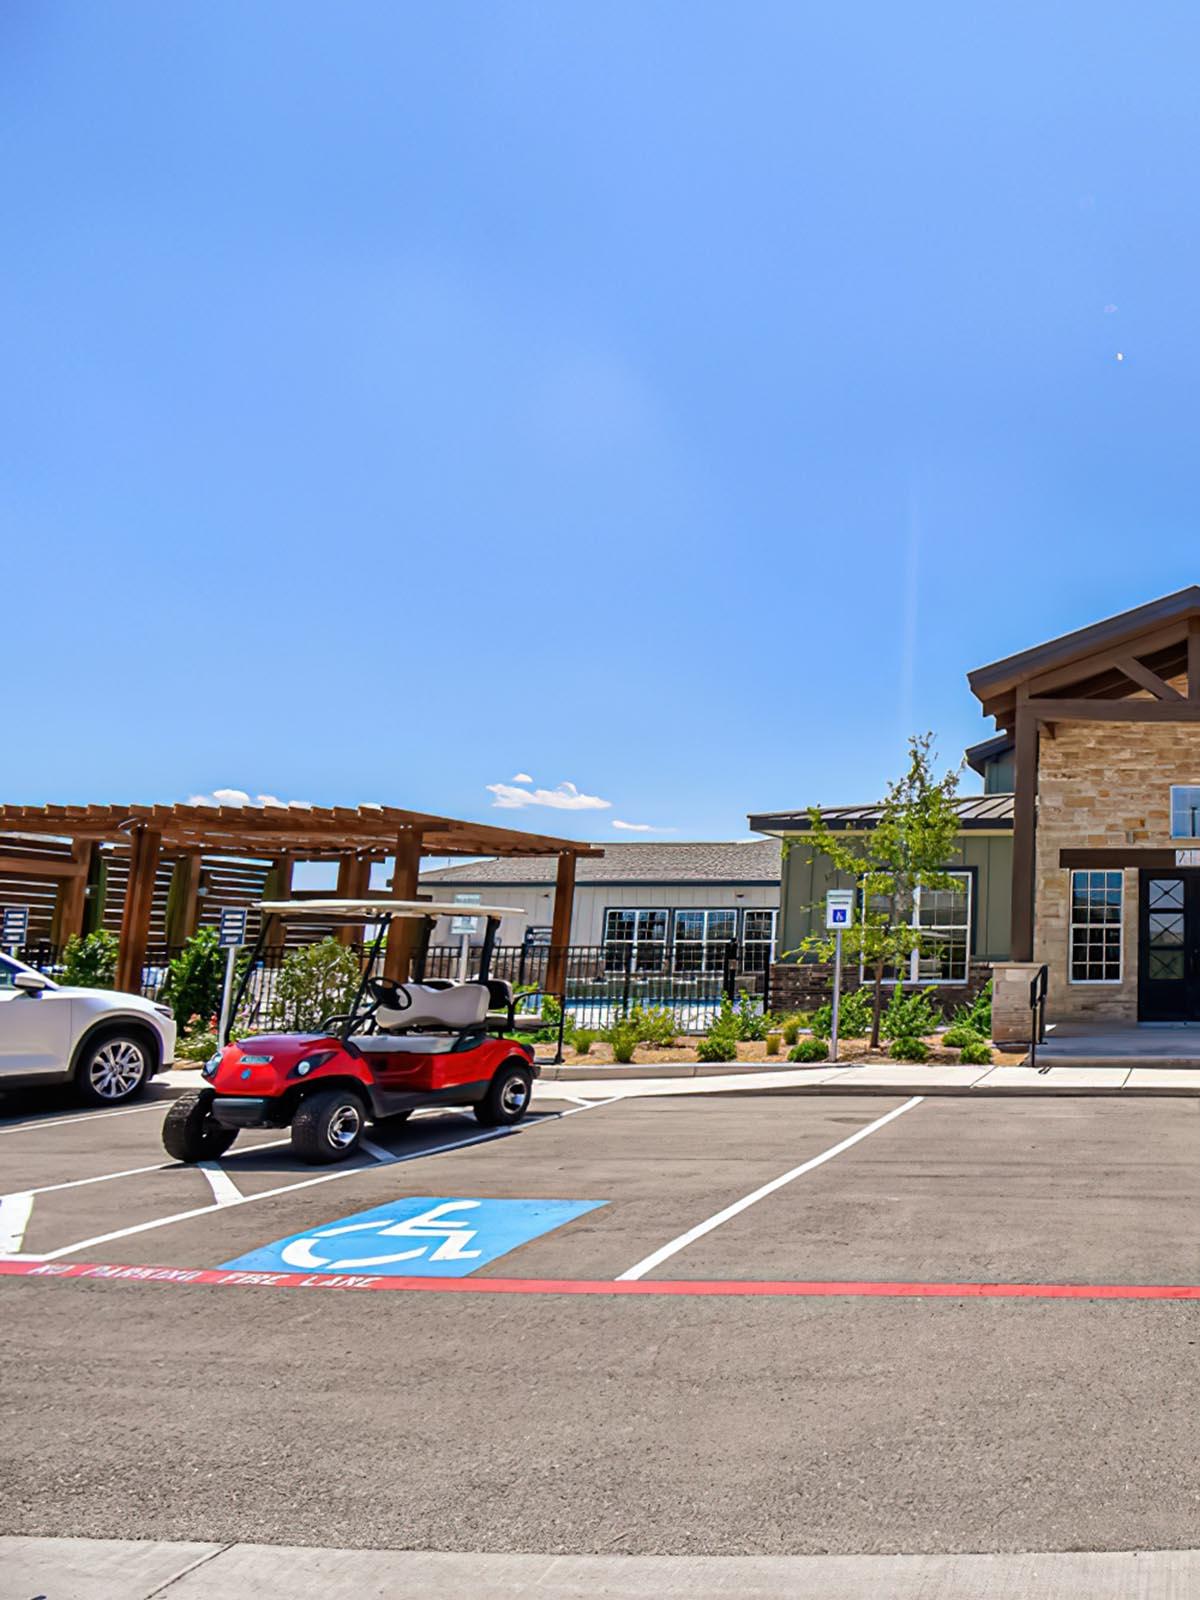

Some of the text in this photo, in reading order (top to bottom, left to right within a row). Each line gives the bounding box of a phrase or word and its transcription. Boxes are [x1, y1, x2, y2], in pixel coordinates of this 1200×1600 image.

[28, 1264, 383, 1288] NO PARKING FIRE LANE
